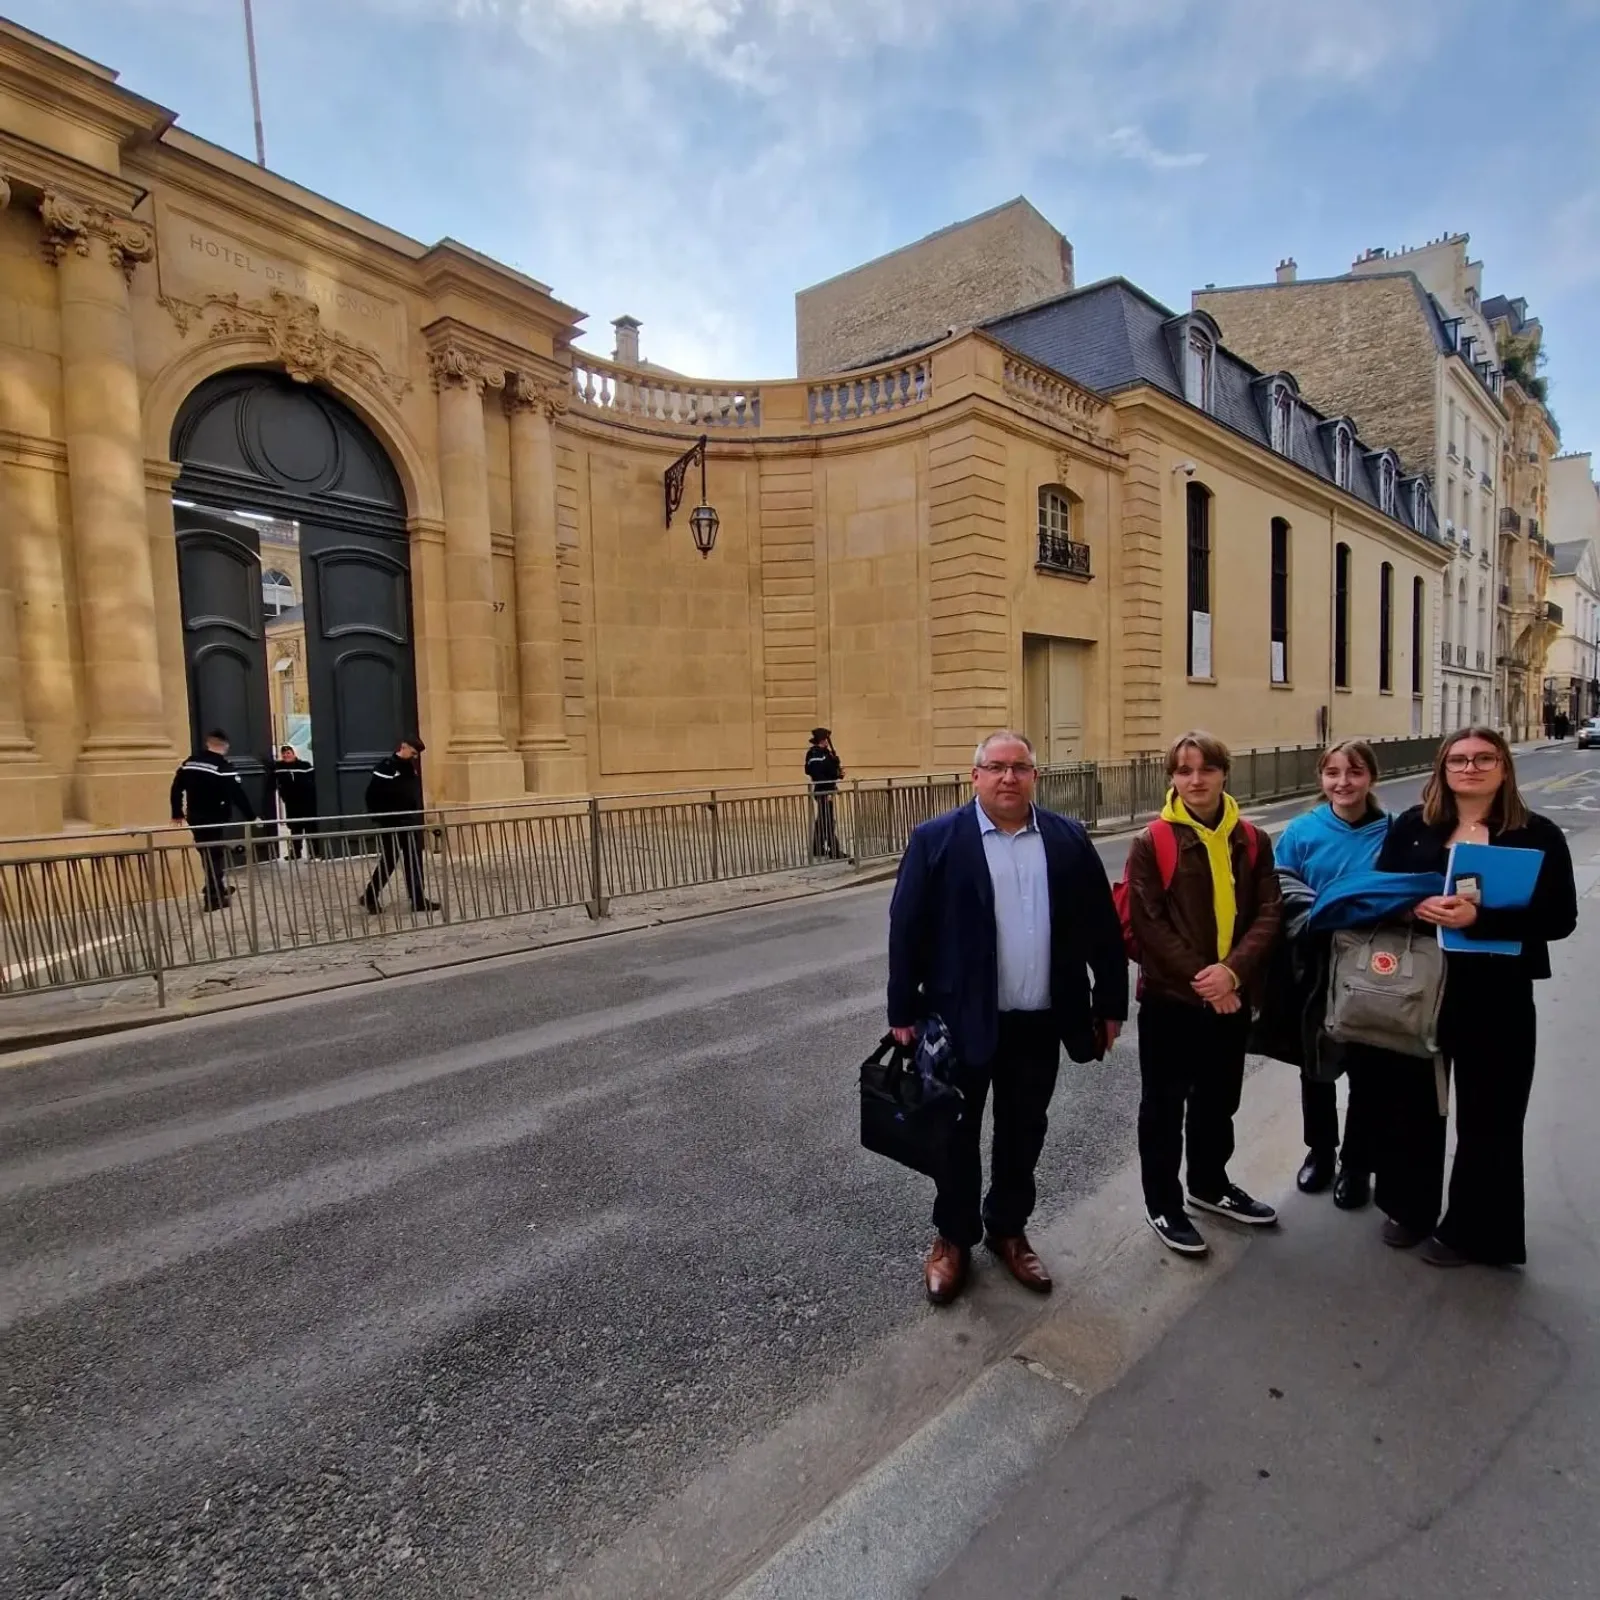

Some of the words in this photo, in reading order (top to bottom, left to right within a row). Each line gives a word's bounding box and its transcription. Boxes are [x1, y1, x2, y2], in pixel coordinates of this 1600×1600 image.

[190, 234, 257, 273] HOTEL
[265, 265, 285, 286] DE
[492, 601, 505, 613] 57
